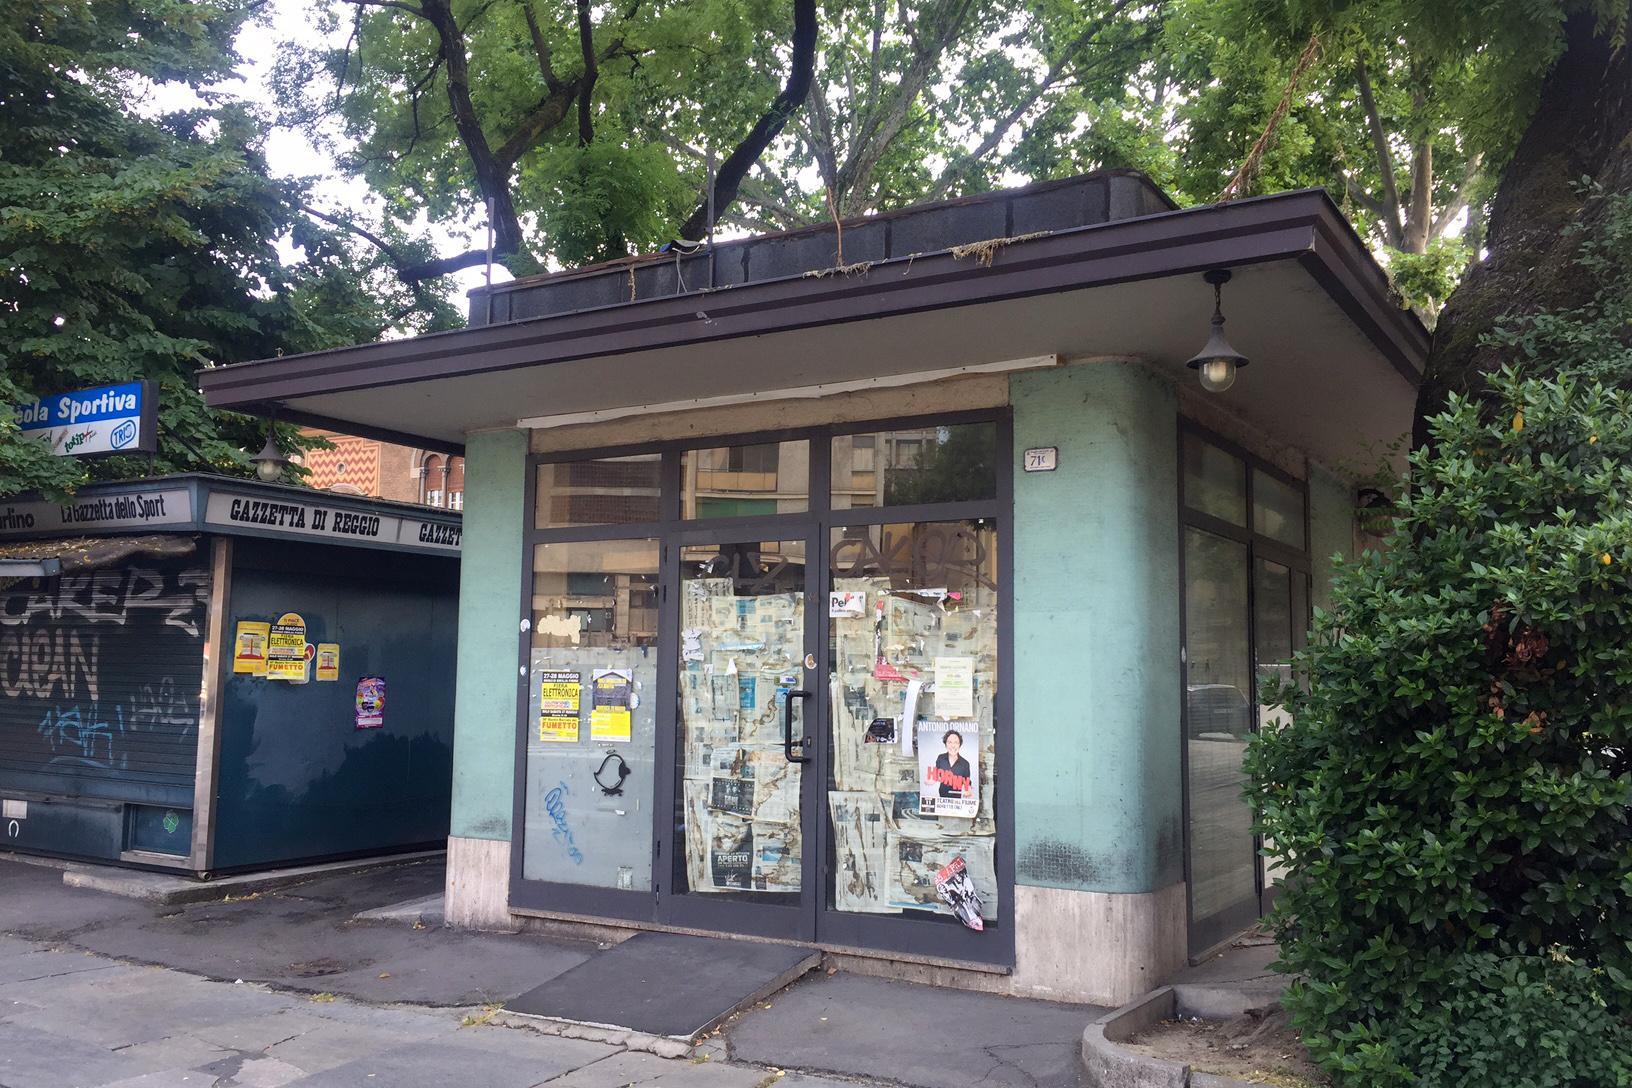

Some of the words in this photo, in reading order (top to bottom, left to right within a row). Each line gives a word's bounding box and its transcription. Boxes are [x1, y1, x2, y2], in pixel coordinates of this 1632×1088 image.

[57, 390, 137, 424] Sportiva
[73, 498, 115, 523] Gazzetta
[115, 496, 137, 520] dello
[138, 494, 167, 521] Sport
[230, 499, 306, 528] GAZZETTA
[312, 509, 328, 531] DI
[332, 513, 380, 537] REGGIO
[271, 637, 304, 648] ELETTRONICA
[543, 688, 579, 698] ELETTRONICA
[542, 721, 577, 730] FUMETTO
[918, 721, 949, 733] ANTONIO
[949, 721, 979, 733] ORNANO
[927, 766, 971, 792] HORNY
